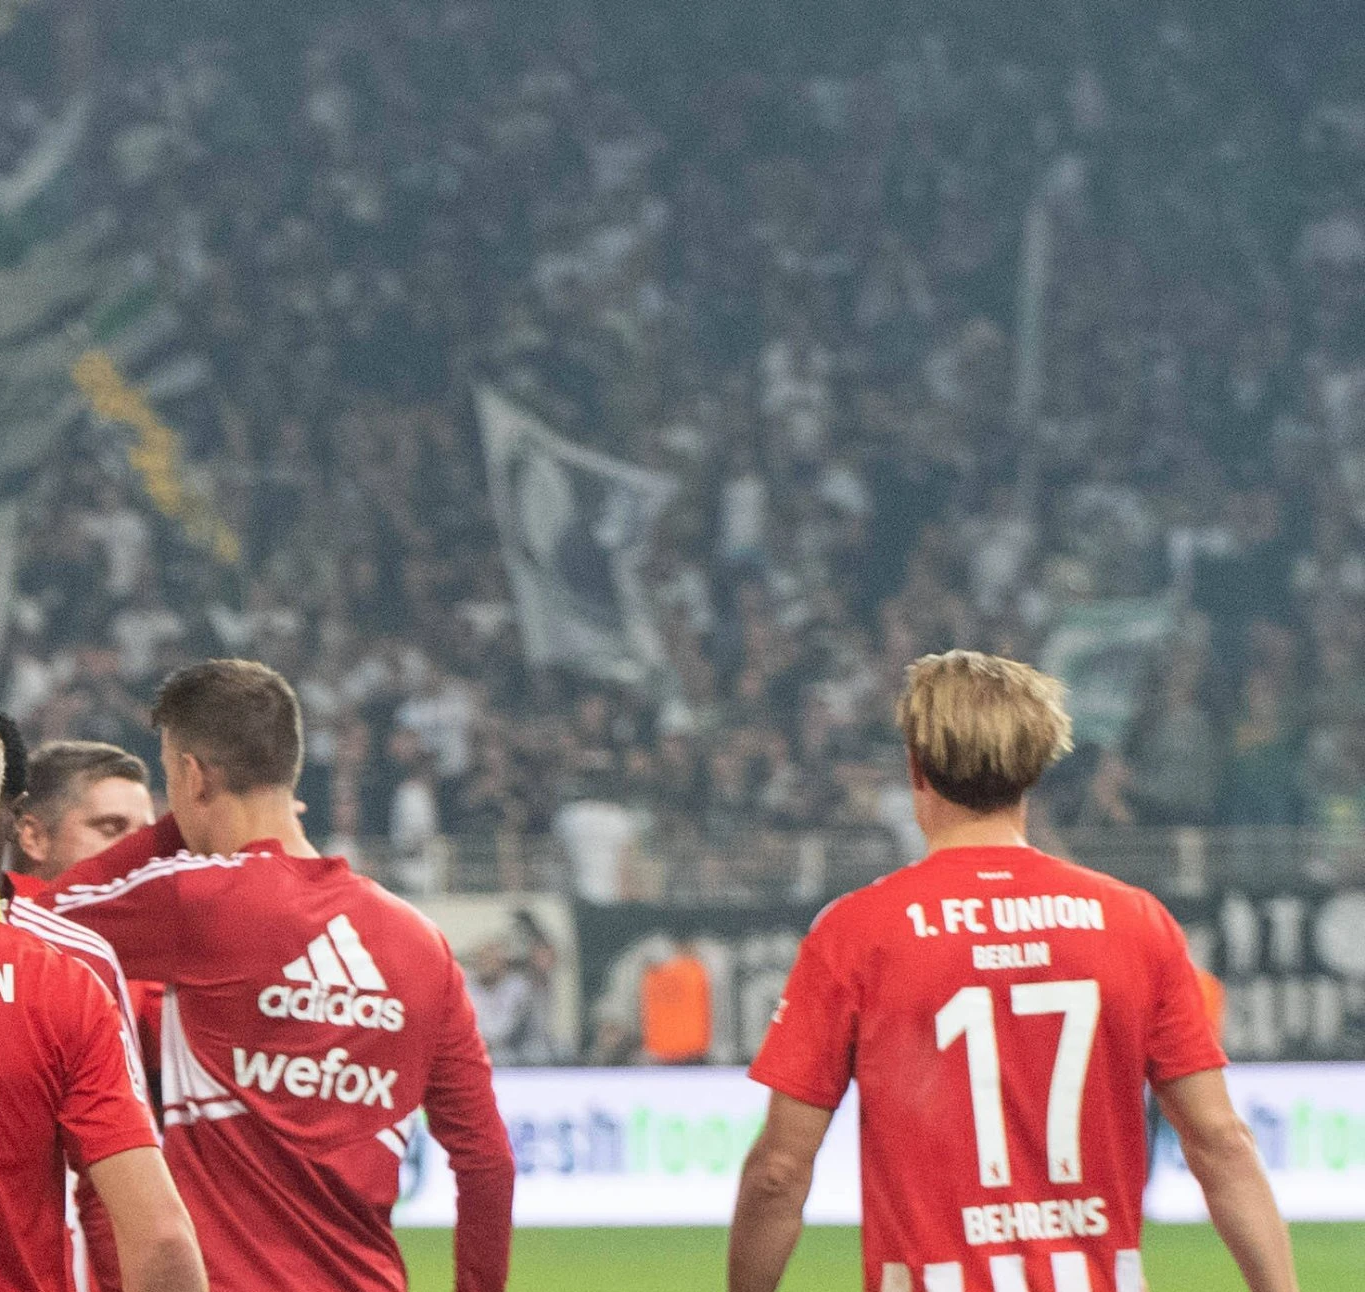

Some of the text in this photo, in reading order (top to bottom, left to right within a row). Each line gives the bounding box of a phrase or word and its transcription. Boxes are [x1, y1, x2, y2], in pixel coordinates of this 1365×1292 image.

[906, 895, 1106, 938] 1. FC UNION
[972, 941, 1051, 970] BERLIN
[257, 979, 406, 1033] adidas
[232, 1047, 399, 1110] wefox
[935, 979, 1101, 1188] 17
[961, 1197, 1109, 1246] BEHRENS
